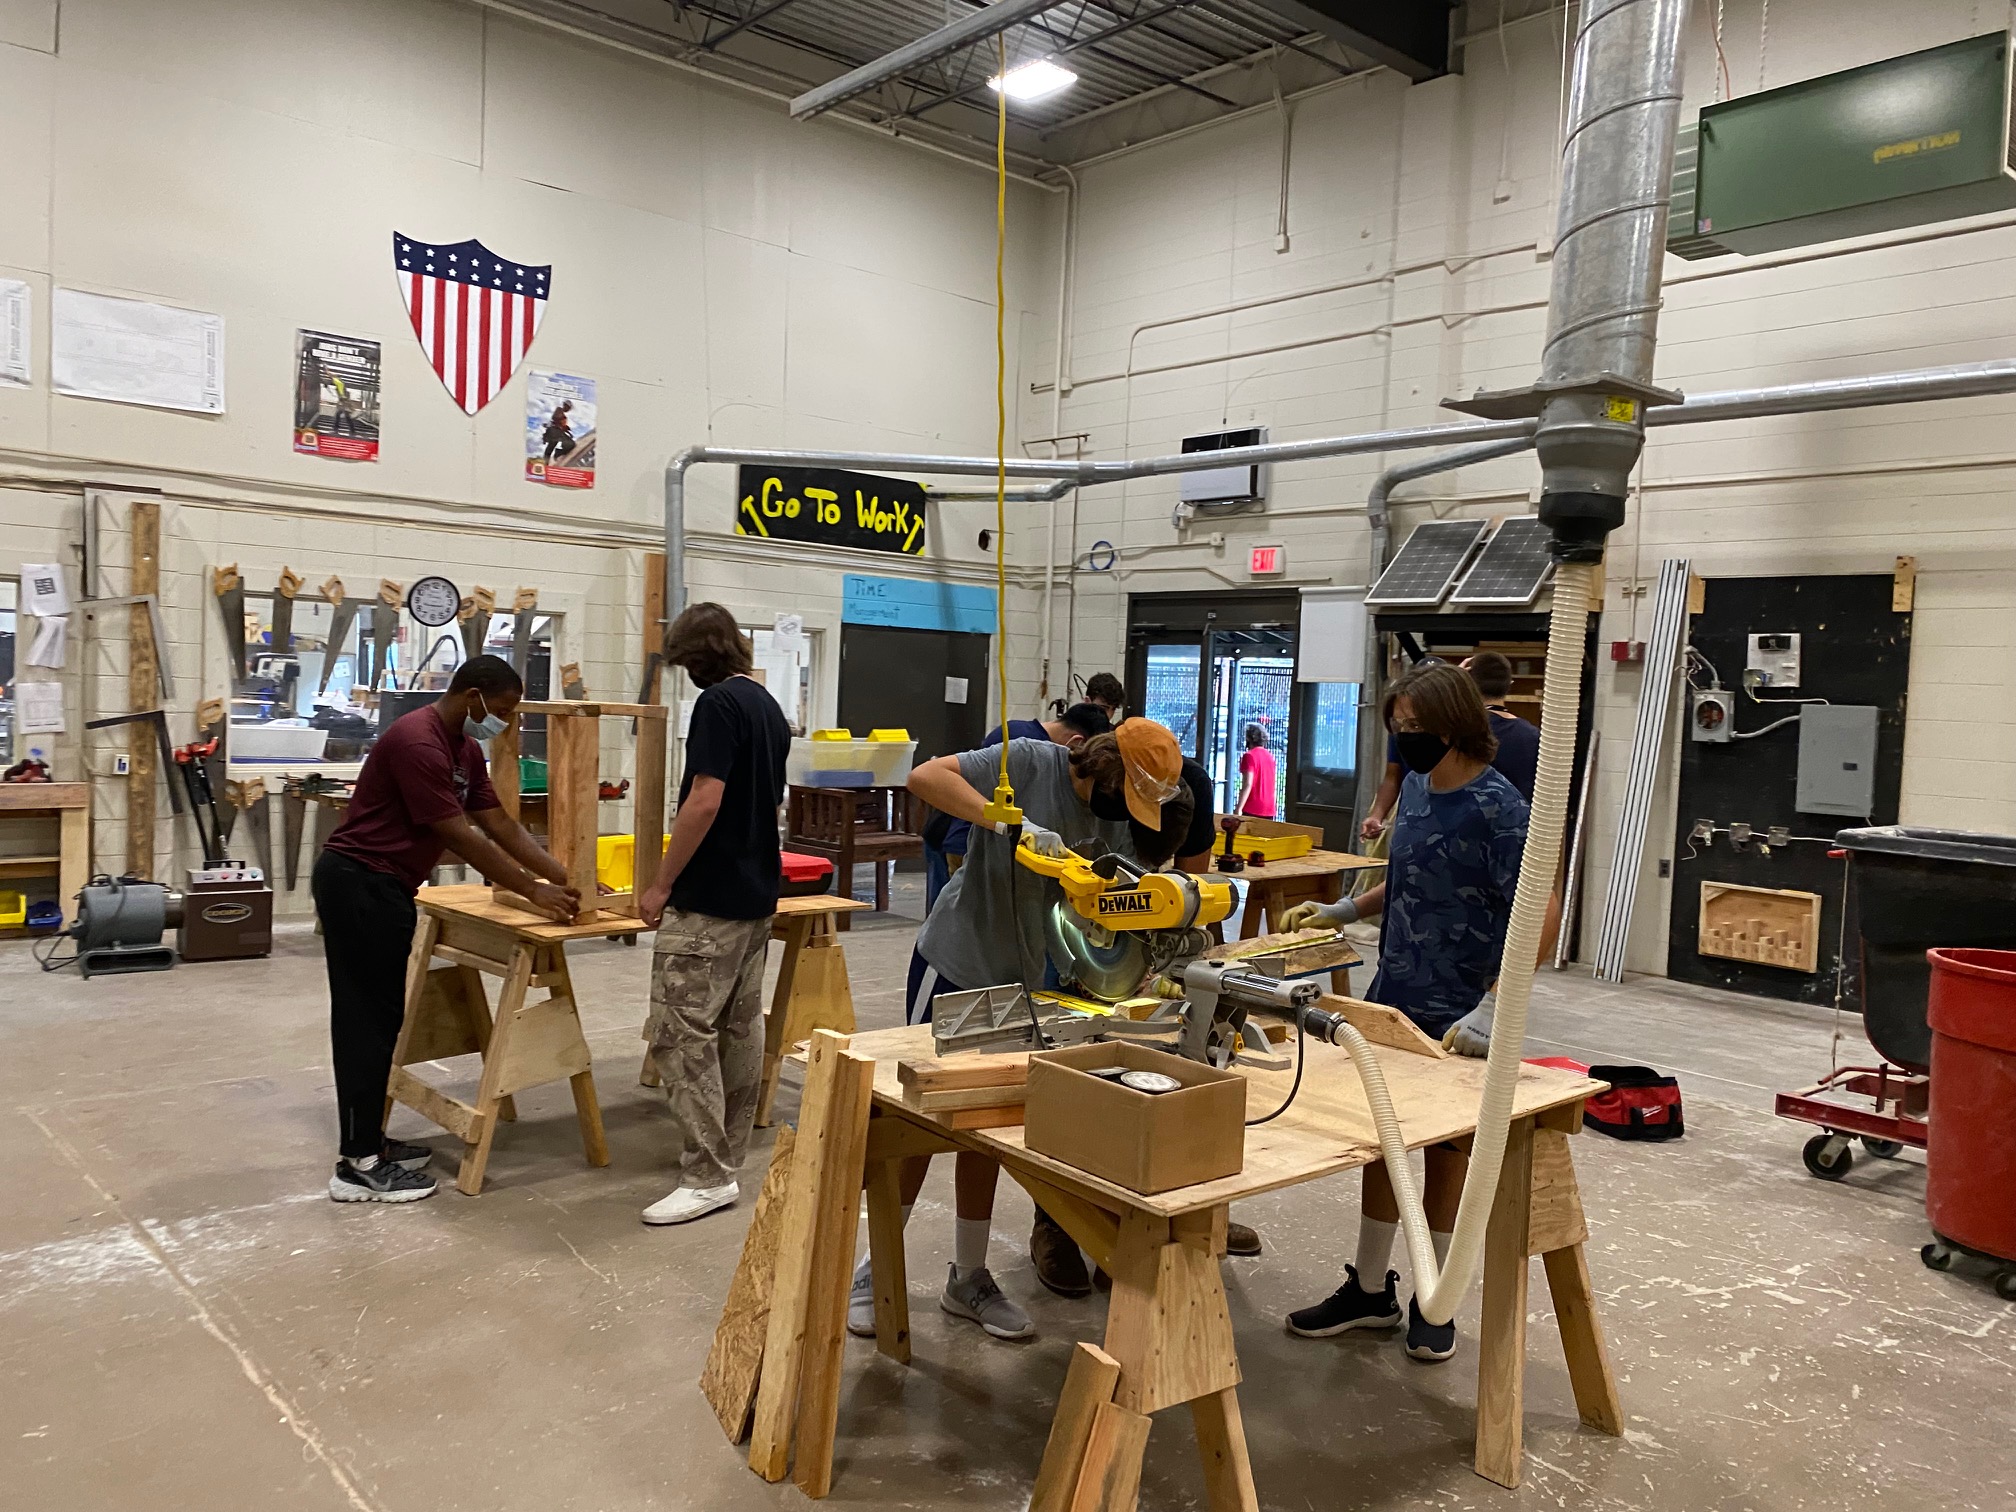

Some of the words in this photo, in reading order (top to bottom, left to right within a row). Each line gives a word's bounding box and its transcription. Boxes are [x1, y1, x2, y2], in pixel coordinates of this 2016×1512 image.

[762, 477, 800, 518] Go
[804, 487, 841, 524] To
[1252, 549, 1276, 571] EXIT
[851, 1274, 871, 1291] adi
